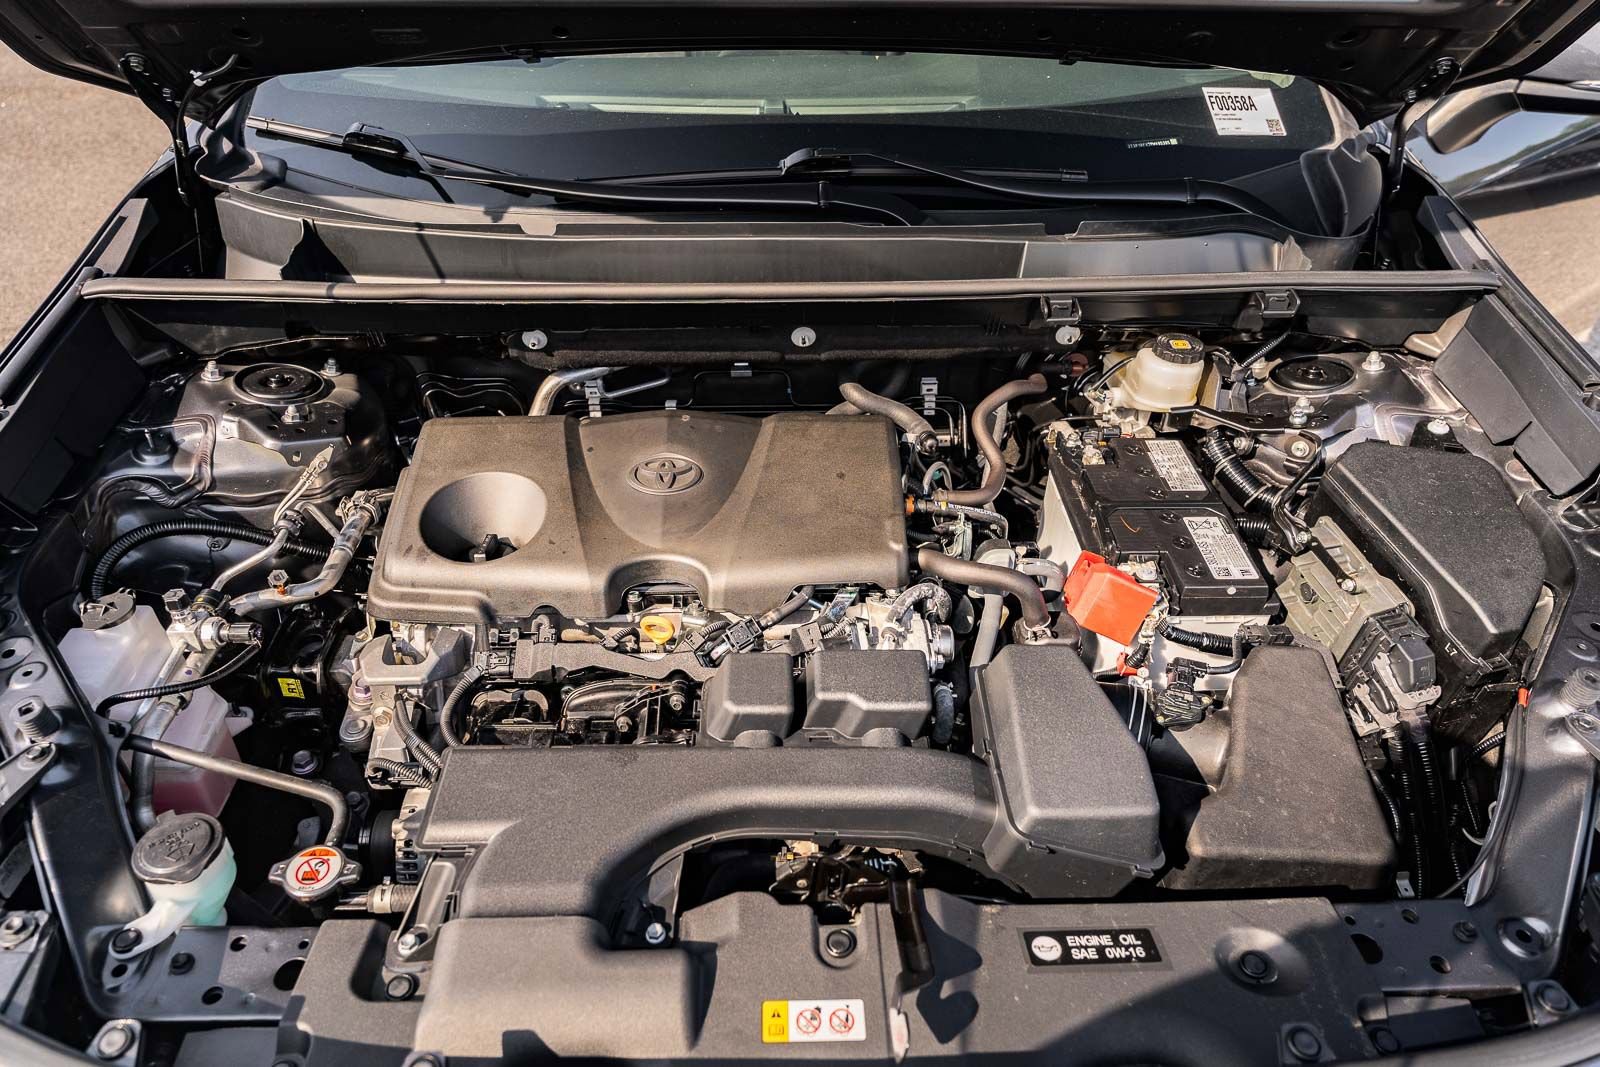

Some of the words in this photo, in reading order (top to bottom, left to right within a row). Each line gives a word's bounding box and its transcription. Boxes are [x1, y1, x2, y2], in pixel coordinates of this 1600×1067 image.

[1208, 95, 1258, 111] F00358A
[1067, 936, 1113, 946] ENGINE
[1120, 935, 1142, 945] OIL
[1072, 949, 1098, 959] SAE
[1106, 948, 1146, 958] 0W-16
